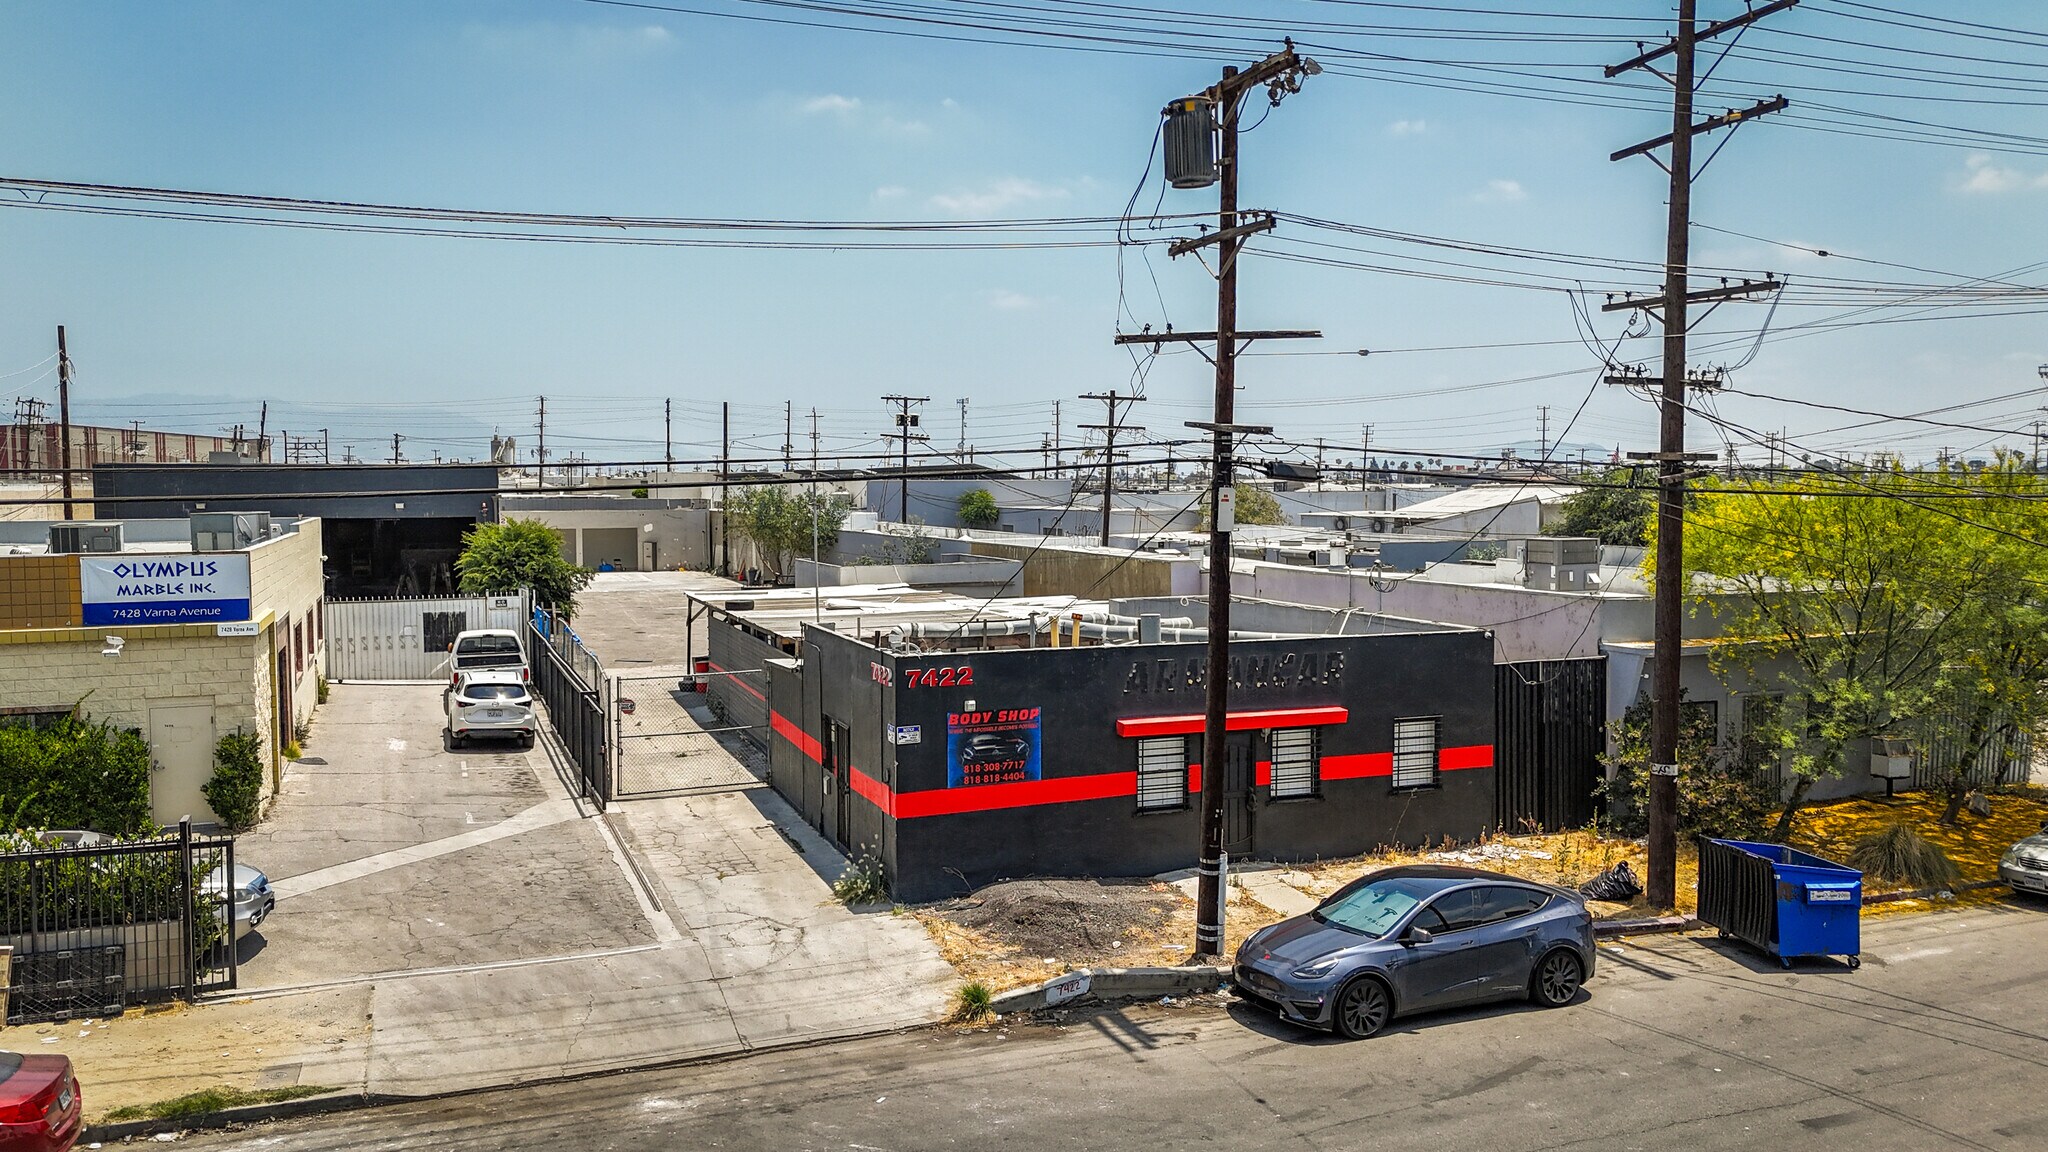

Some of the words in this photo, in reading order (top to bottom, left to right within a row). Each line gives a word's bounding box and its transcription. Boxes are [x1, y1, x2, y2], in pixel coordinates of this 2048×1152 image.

[113, 561, 218, 578] OLYMPUS
[117, 583, 184, 596] MARBLE
[190, 583, 216, 593] INC.
[112, 609, 141, 618] 7428
[143, 608, 177, 617] Varna
[179, 607, 221, 616] Avenue
[905, 666, 974, 688] 7422
[949, 712, 992, 725] BODY
[998, 708, 1039, 722] SHOP
